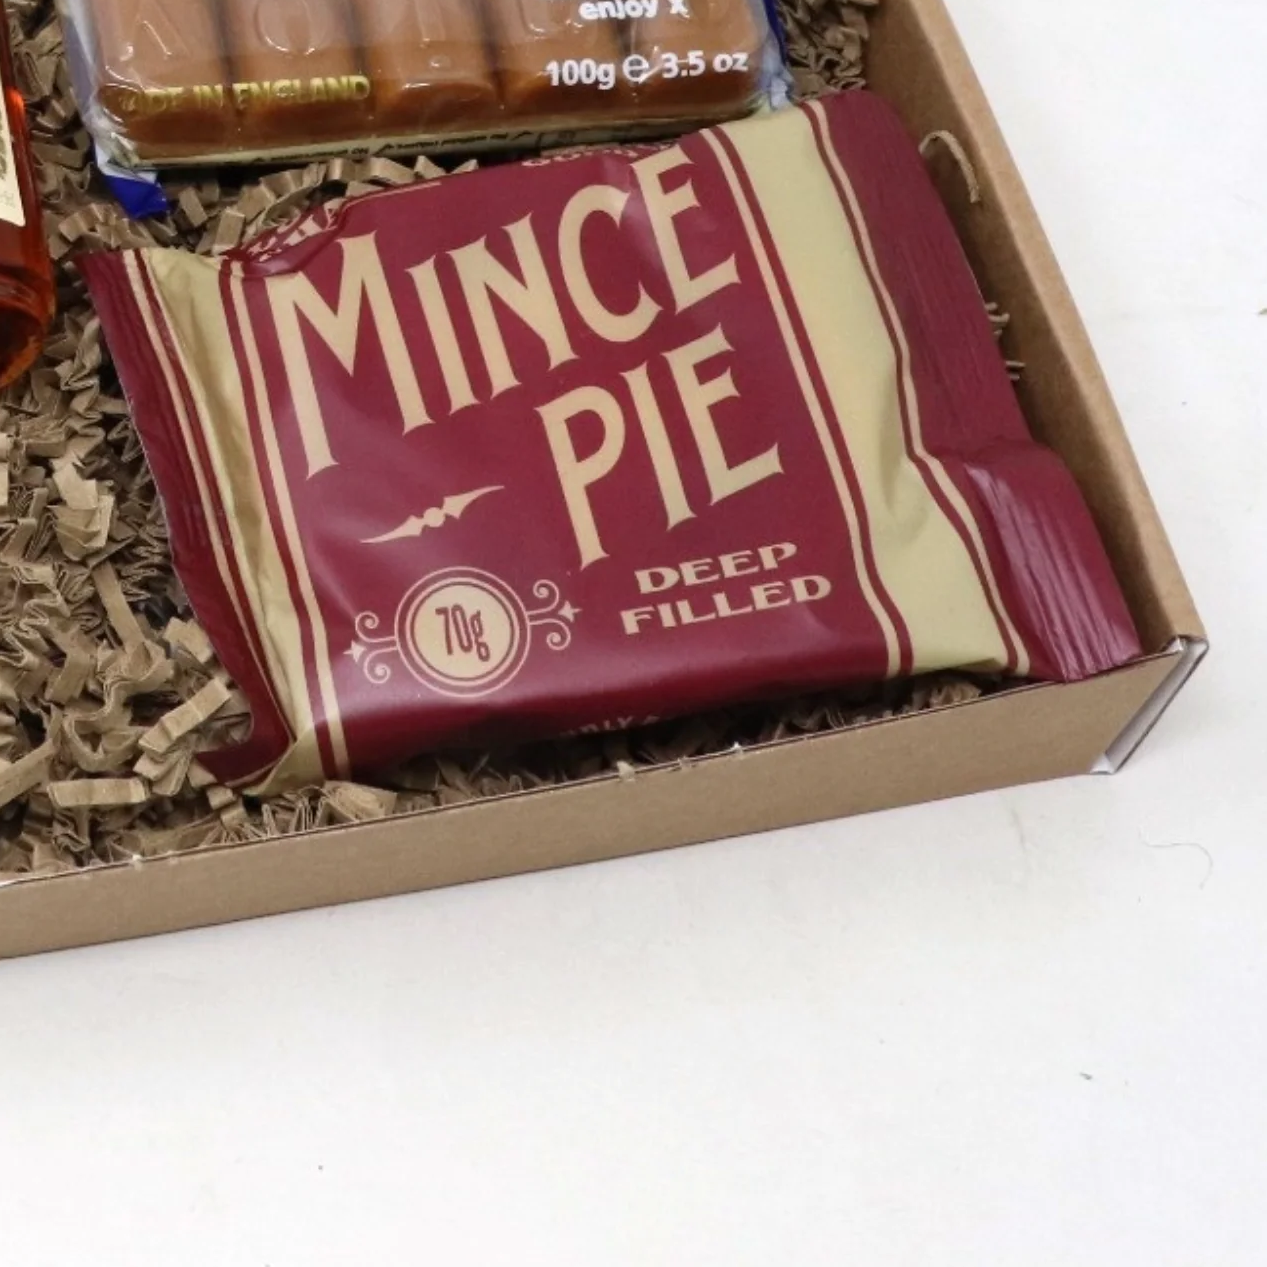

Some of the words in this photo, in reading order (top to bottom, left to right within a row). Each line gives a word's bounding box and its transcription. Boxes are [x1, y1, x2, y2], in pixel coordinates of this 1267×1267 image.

[193, 84, 224, 110] IN
[232, 75, 371, 111] ENGLAND
[545, 57, 617, 91] 100g
[660, 49, 706, 79] 3.5
[712, 51, 749, 73] oz
[266, 144, 742, 481] MINCE
[534, 322, 784, 570] PIE
[635, 541, 798, 595] DEEP
[434, 603, 492, 663] 70g
[620, 574, 832, 636] FILLED
